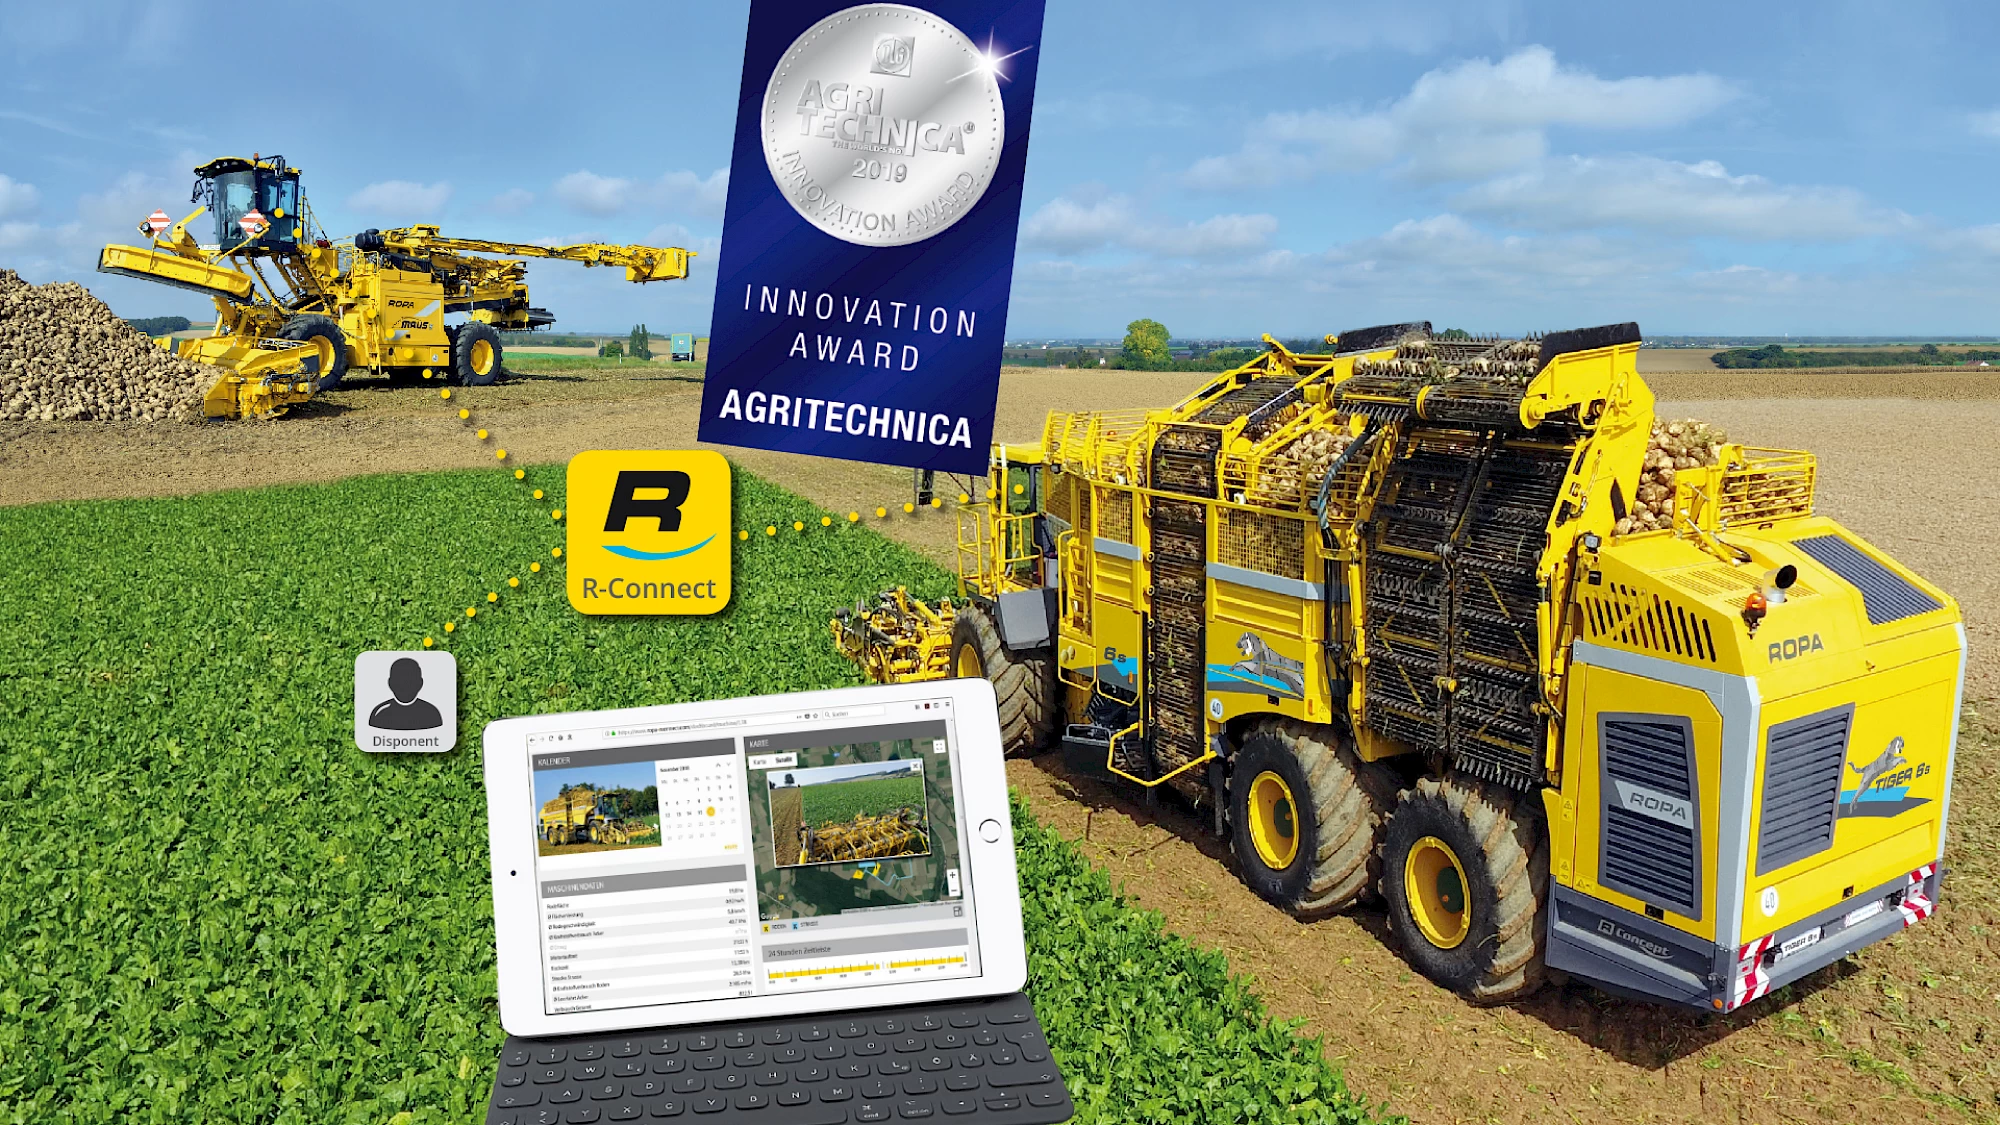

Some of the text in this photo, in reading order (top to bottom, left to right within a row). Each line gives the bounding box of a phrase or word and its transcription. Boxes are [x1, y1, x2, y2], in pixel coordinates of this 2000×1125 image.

[388, 299, 414, 309] ROPA
[401, 320, 429, 330] MAUS
[1768, 633, 1825, 664] ROPA
[1211, 703, 1221, 716] 40
[1876, 767, 1913, 793] TIGER
[1629, 791, 1687, 820] ROPA
[1765, 892, 1775, 910] 40
[1616, 928, 1669, 956] Concept
[1784, 935, 1806, 951] TIGER
[768, 950, 776, 958] 24
[776, 948, 803, 957] Stunden
